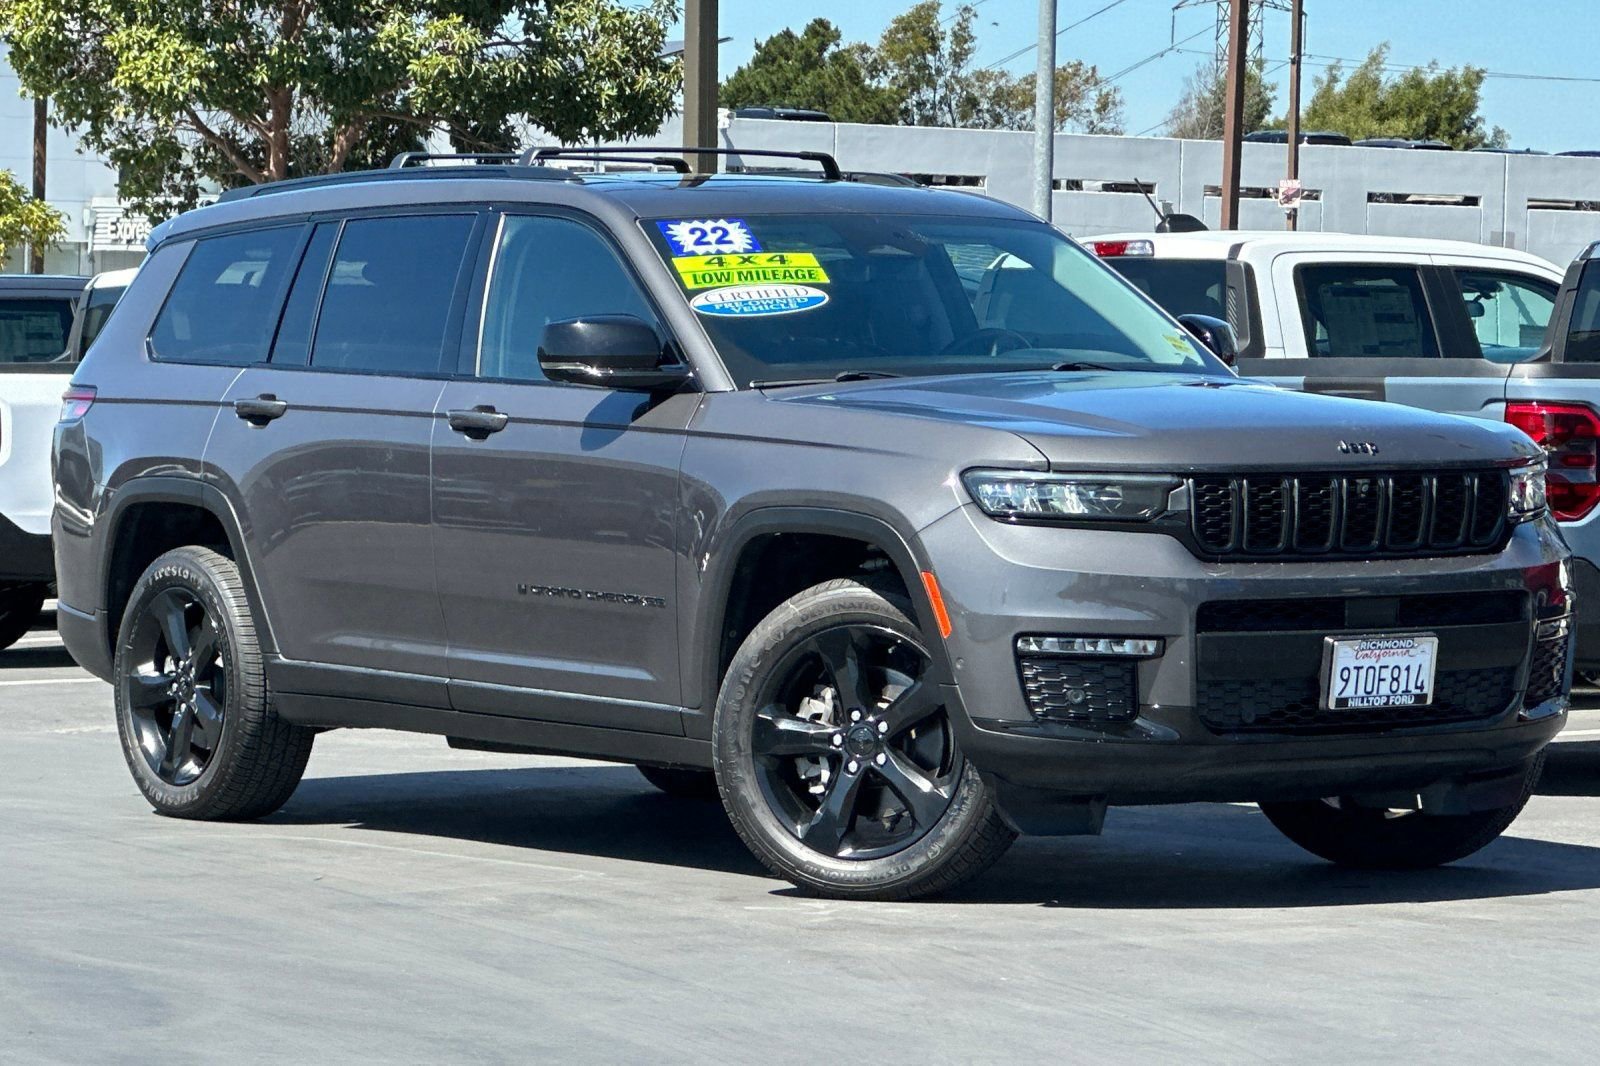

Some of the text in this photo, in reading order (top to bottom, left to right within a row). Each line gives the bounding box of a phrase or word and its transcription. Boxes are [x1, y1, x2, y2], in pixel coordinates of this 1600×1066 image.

[688, 226, 735, 246] 22
[692, 268, 817, 285] LOW MILEAGE
[704, 287, 809, 303] CERTIFIED
[714, 297, 809, 310] PRE-OWNED
[731, 303, 800, 314] VEHICLE
[1360, 640, 1414, 650] RICHMOND
[1355, 649, 1415, 662] California
[1348, 695, 1415, 707] HILLTOP FORD
